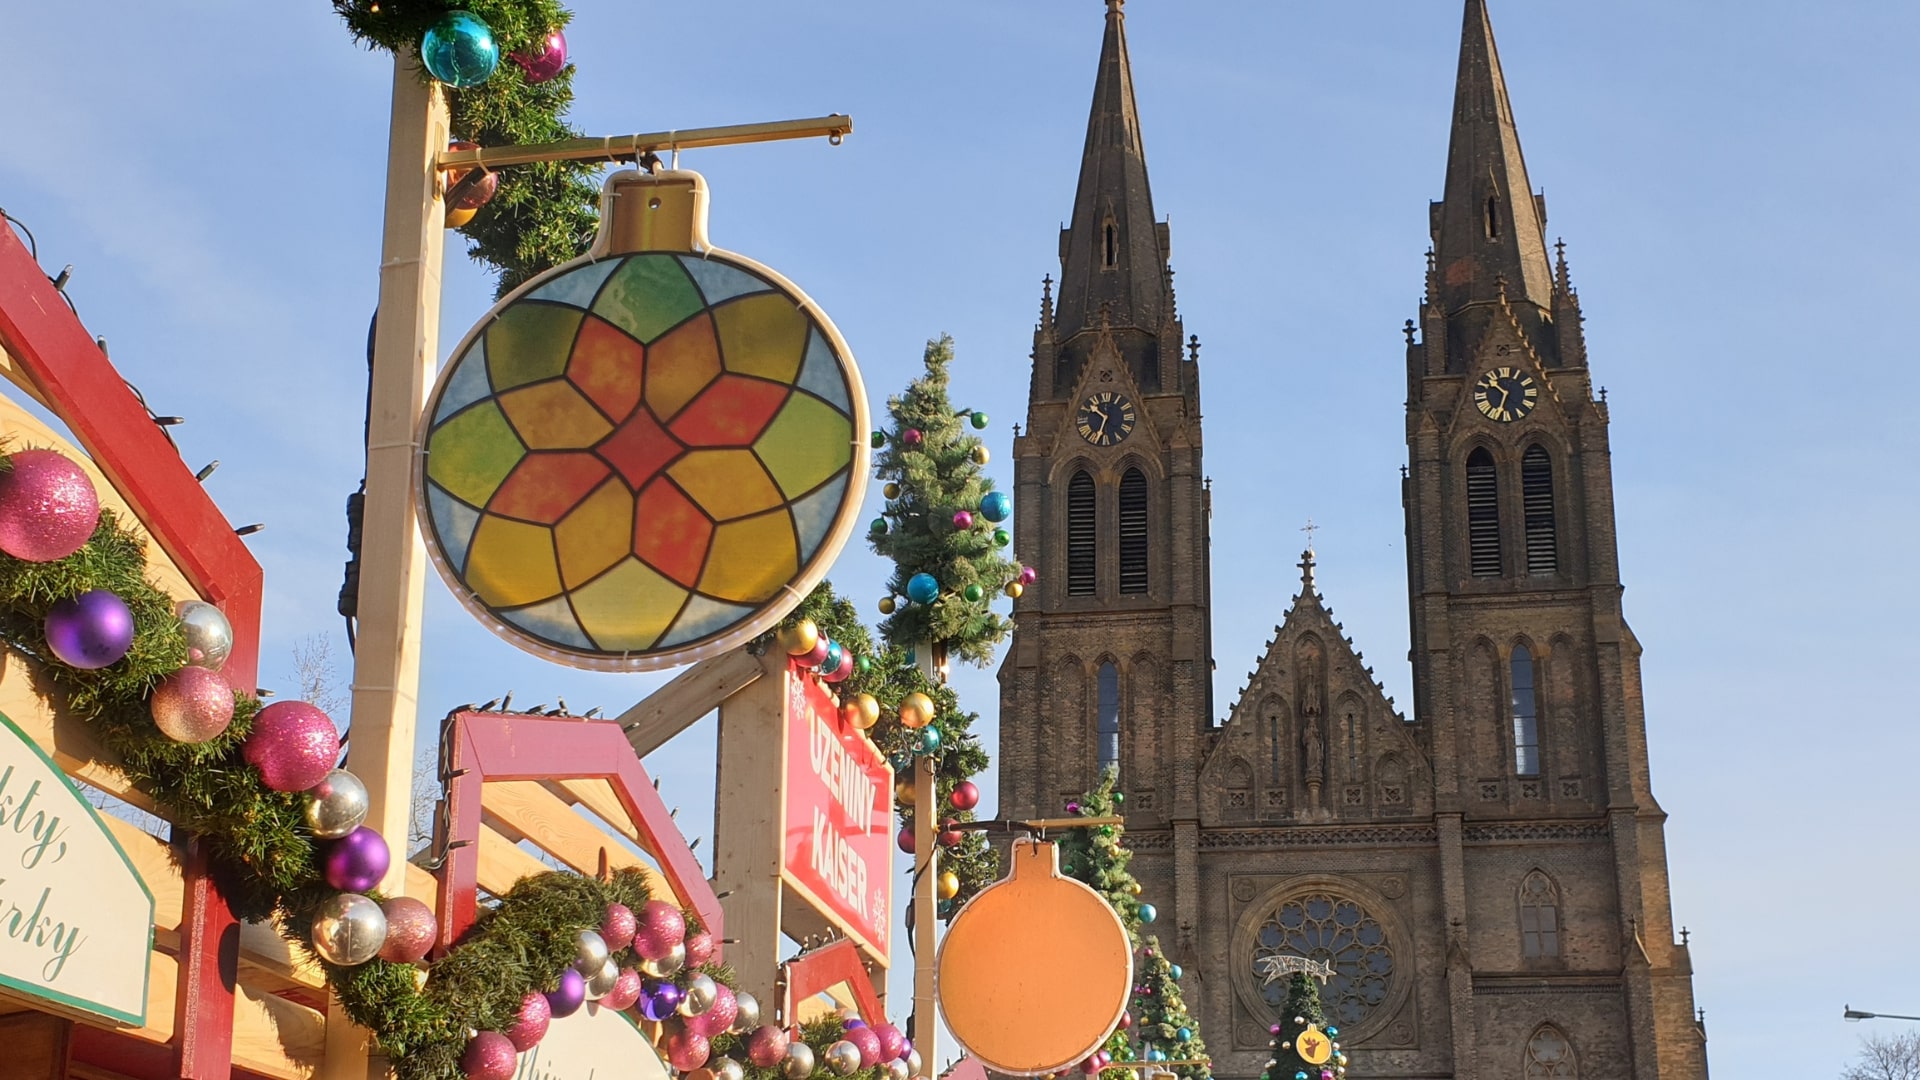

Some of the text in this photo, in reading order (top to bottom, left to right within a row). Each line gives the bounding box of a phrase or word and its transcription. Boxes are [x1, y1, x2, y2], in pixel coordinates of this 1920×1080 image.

[809, 706, 876, 838] UZENINY
[811, 805, 868, 920] KAISER
[0, 879, 88, 982] rky
